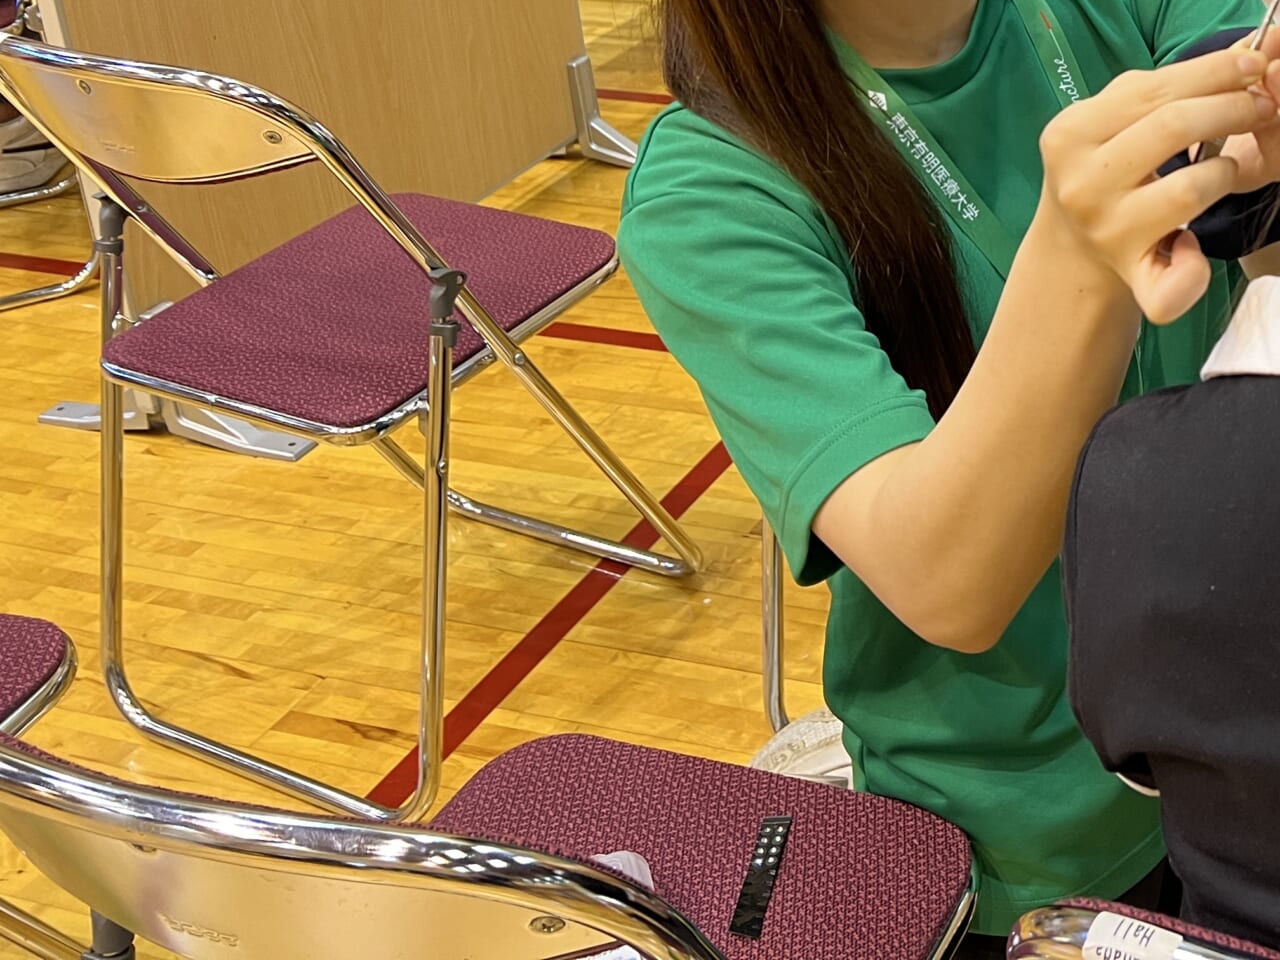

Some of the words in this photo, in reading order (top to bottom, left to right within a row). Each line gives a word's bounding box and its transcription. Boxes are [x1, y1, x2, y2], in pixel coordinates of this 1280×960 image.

[886, 112, 981, 222] 東京有明医療大学
[1112, 919, 1157, 948] Hall
